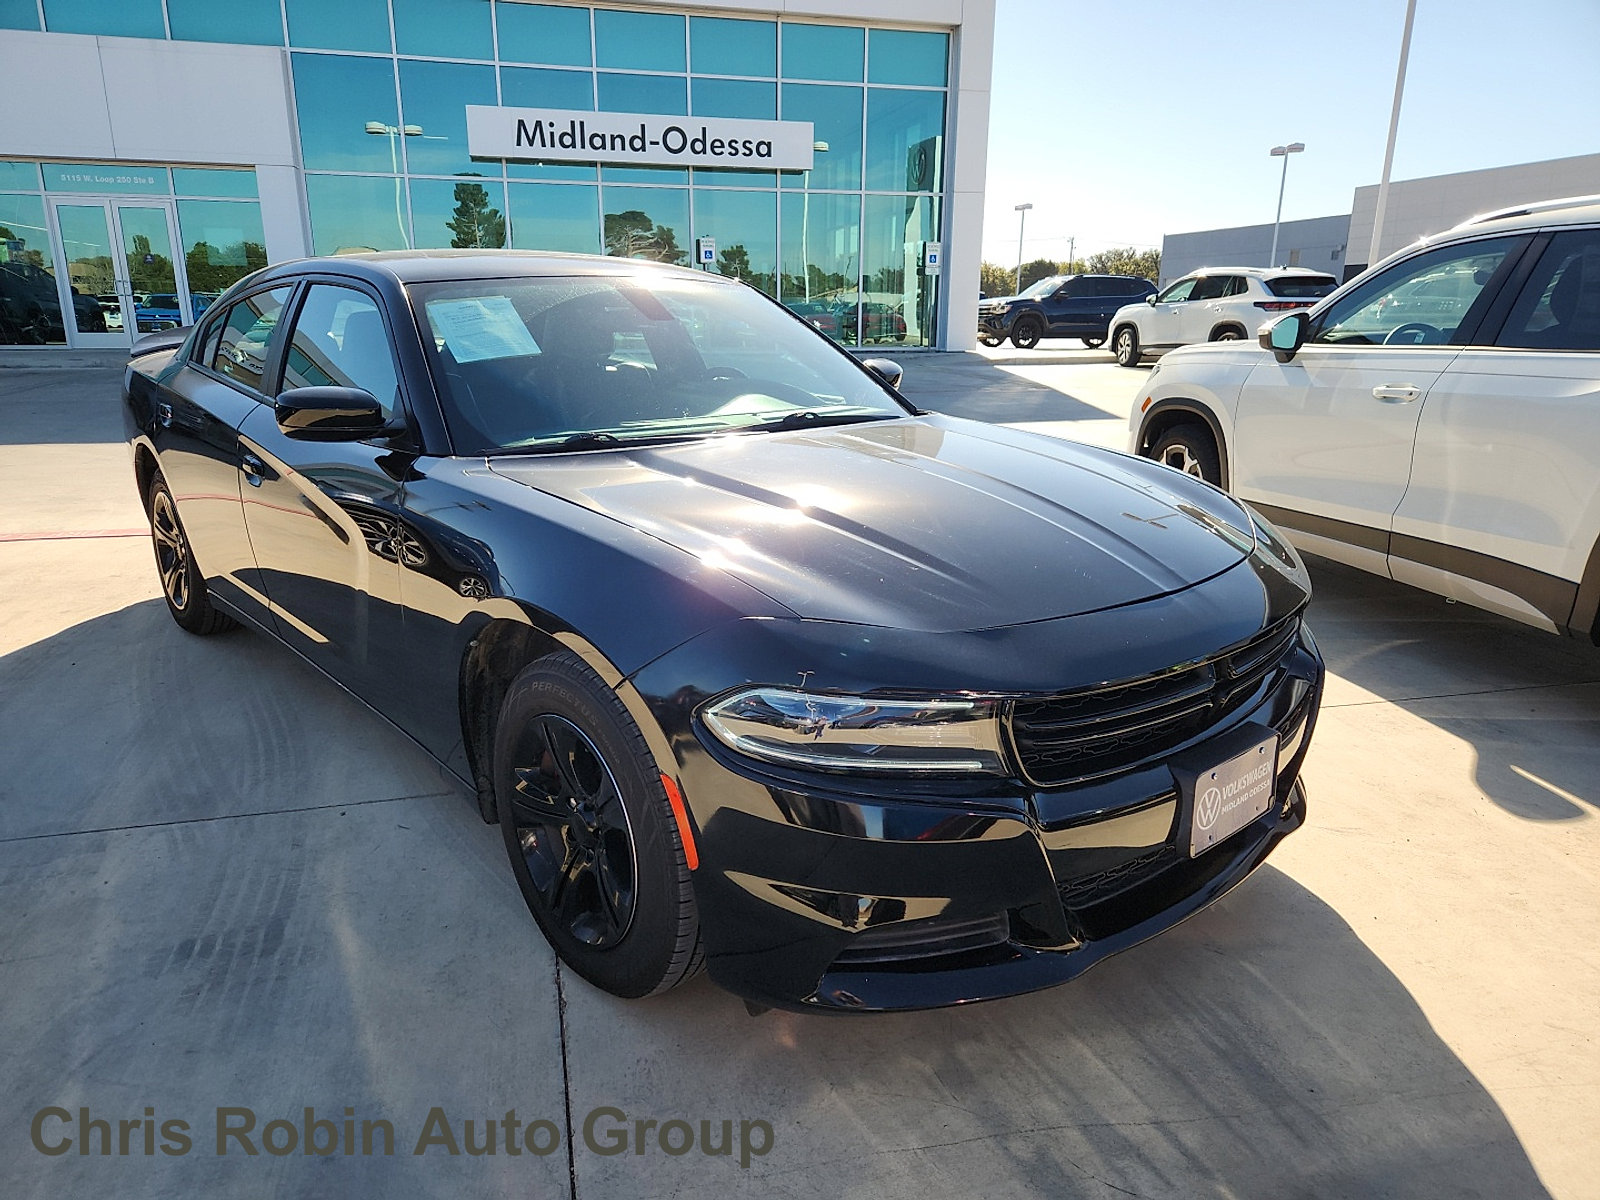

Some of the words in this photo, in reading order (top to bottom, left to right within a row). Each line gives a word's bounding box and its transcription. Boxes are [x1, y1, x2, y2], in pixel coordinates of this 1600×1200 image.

[515, 118, 773, 159] Midland-Odessa
[95, 175, 115, 184] Loop
[1222, 760, 1273, 801] VOLKSWAGEN
[1221, 792, 1249, 815] MIDLAND
